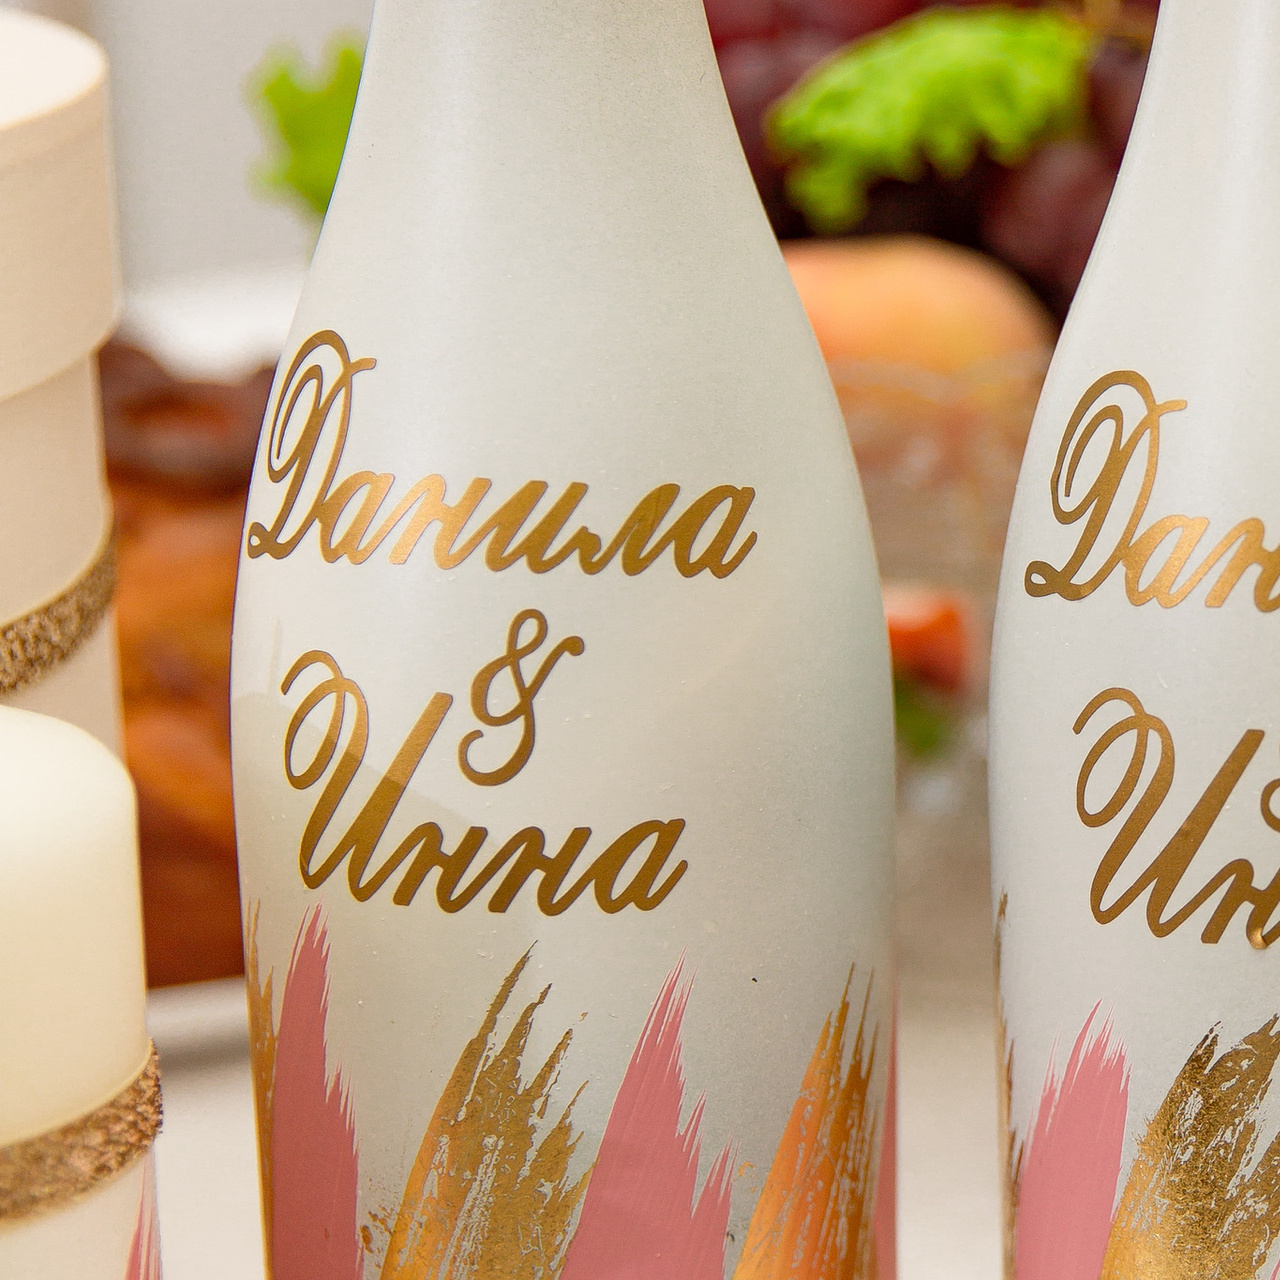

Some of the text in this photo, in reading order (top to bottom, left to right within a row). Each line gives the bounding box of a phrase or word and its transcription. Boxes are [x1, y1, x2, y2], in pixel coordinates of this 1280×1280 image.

[246, 329, 757, 579] Данила
[279, 650, 687, 916] Инна
[457, 608, 584, 786] &
